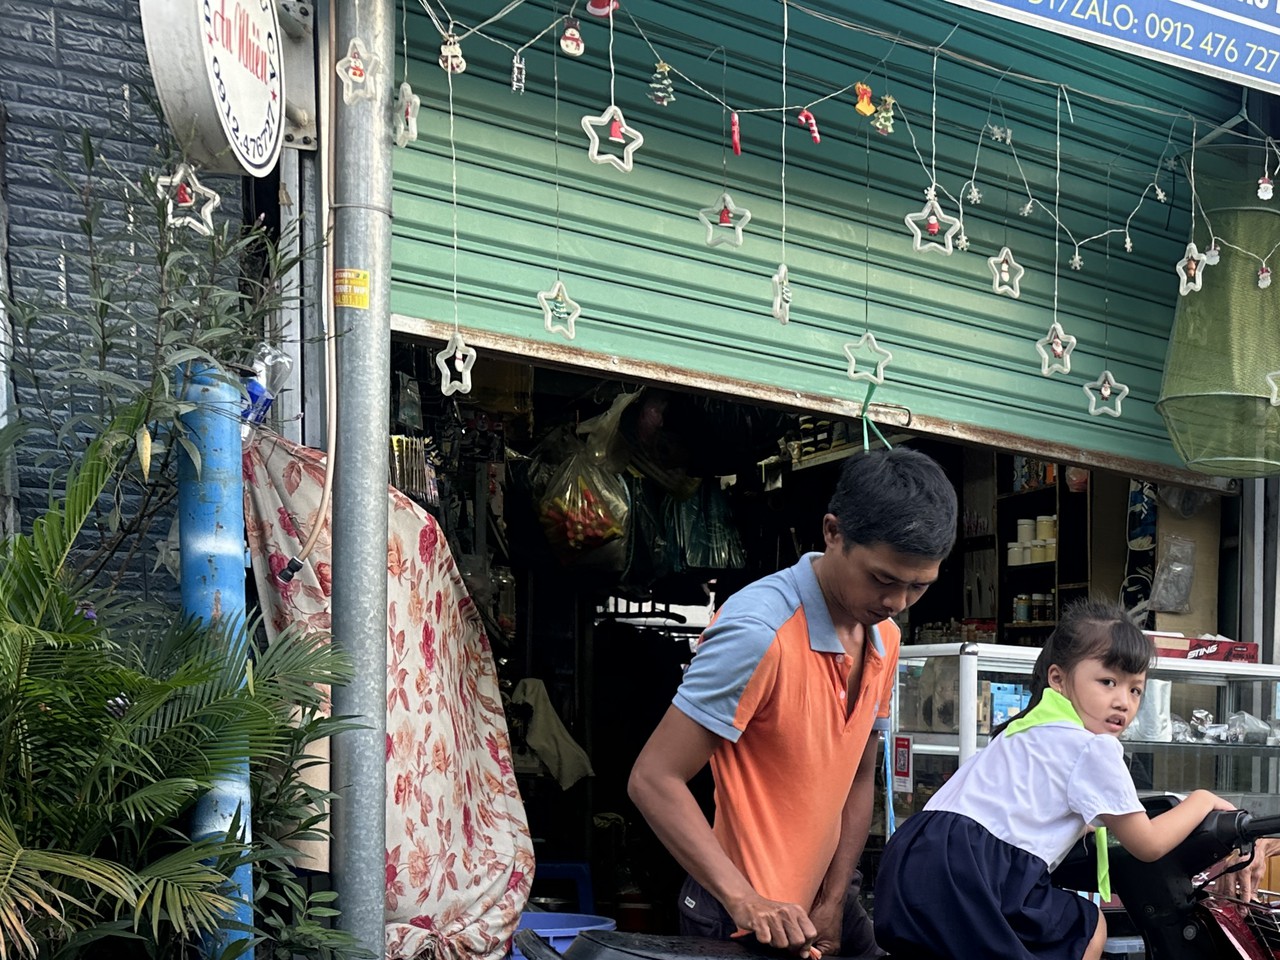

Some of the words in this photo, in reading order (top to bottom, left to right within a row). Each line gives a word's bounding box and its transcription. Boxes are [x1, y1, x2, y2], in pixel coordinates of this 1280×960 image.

[1145, 13, 1195, 50] 0912
[1200, 31, 1238, 63] 476
[1244, 43, 1280, 73] 727
[213, 56, 276, 158] 0912.476727
[1187, 644, 1218, 659] STING
